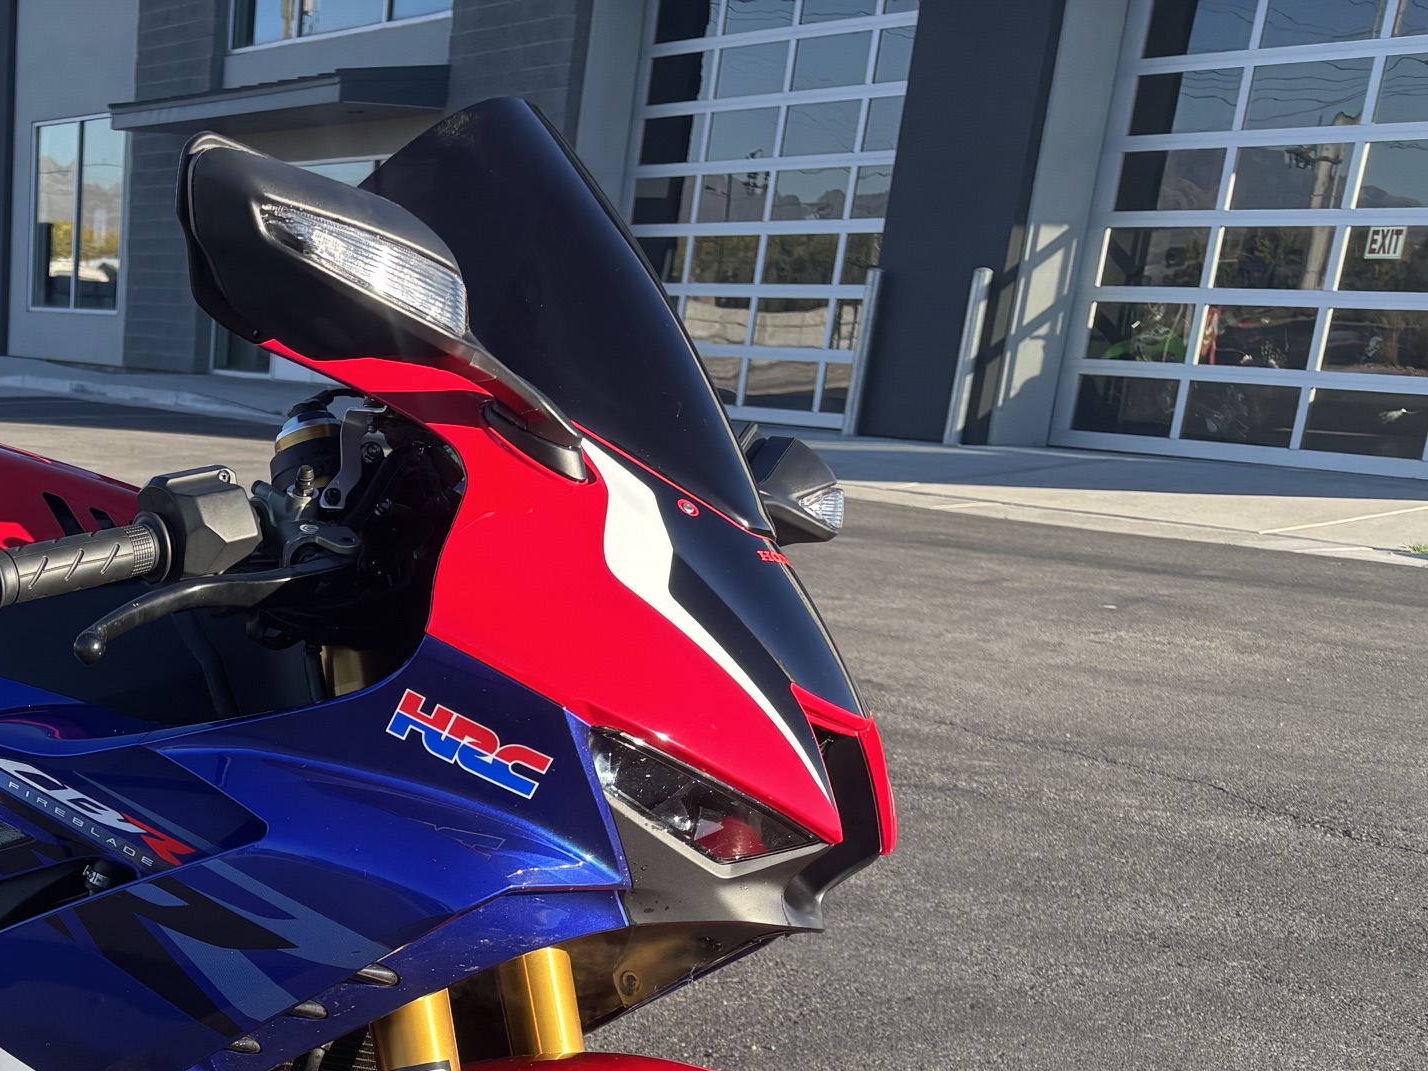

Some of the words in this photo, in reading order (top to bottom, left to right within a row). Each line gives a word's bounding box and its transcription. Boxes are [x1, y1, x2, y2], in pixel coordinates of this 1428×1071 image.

[1368, 229, 1404, 255] EXIT
[385, 687, 554, 800] HRC
[8, 780, 154, 867] FIREBLADE
